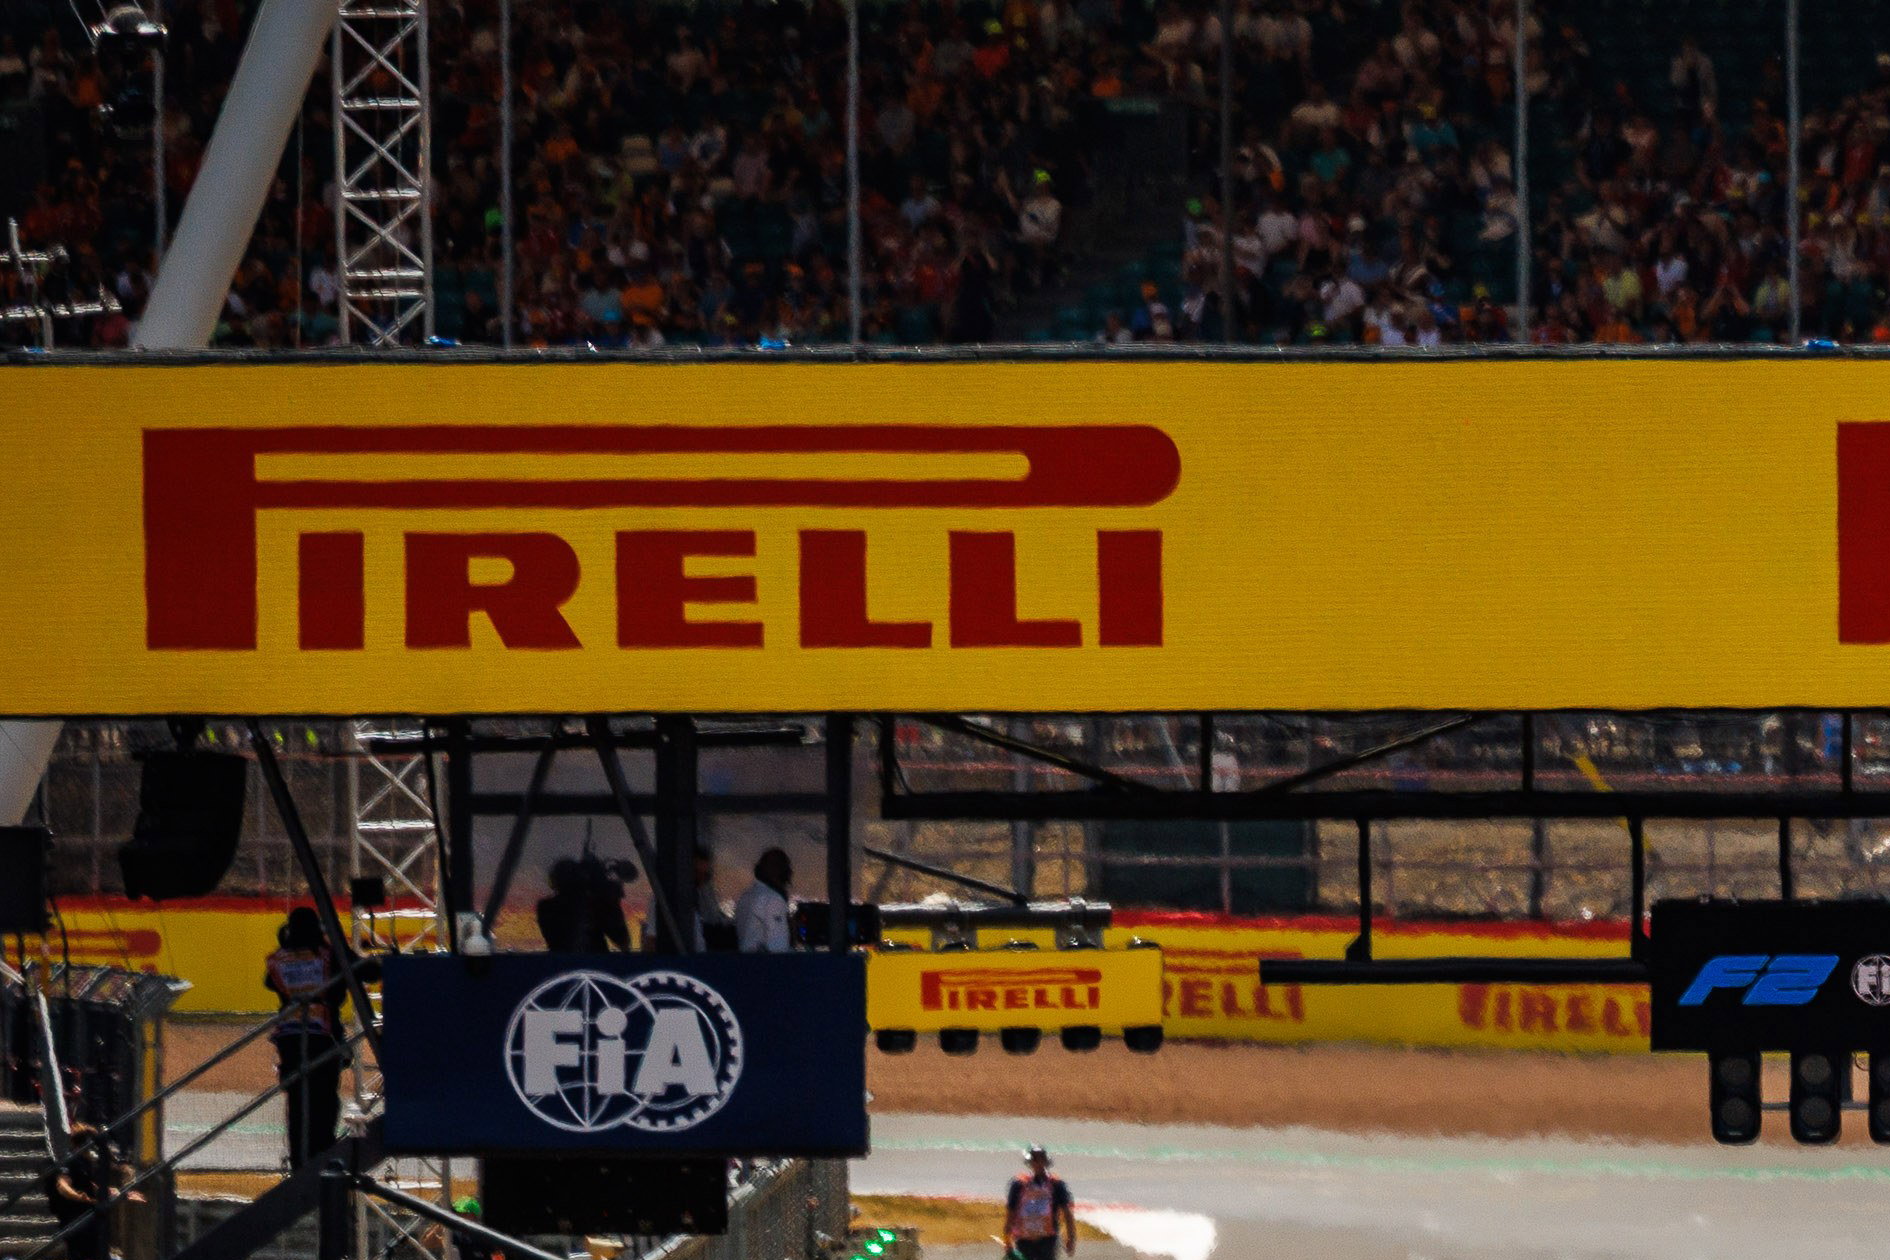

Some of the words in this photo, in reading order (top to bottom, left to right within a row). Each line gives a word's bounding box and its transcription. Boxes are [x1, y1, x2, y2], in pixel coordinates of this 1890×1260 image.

[142, 424, 1181, 651] PIRELLI
[921, 967, 1102, 1012] PIRELLI
[1679, 954, 1840, 1006] F2
[1460, 983, 1651, 1036] IREL
